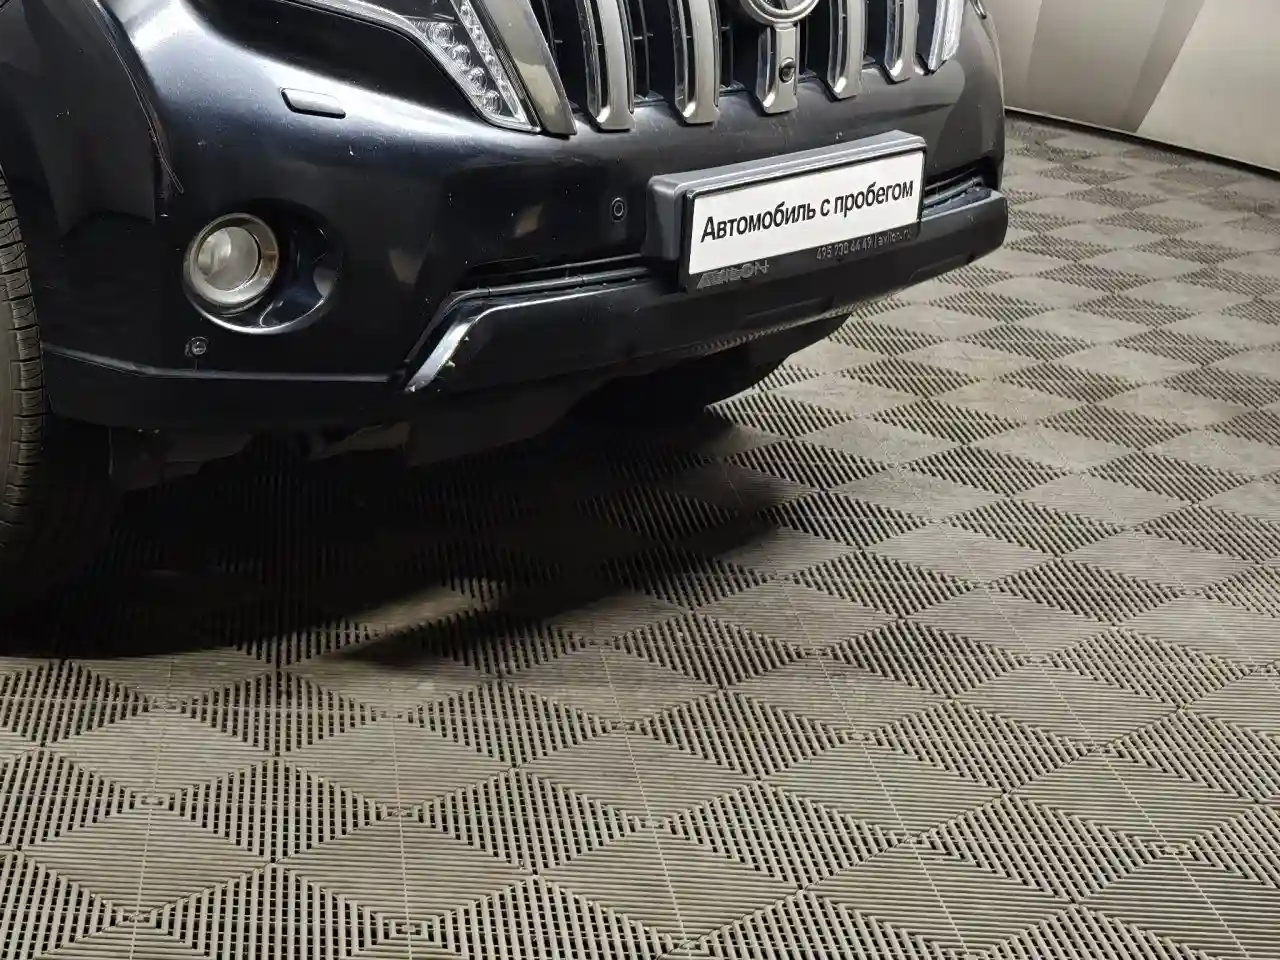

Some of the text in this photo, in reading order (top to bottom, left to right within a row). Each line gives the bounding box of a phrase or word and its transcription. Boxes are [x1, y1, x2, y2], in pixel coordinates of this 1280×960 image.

[700, 179, 914, 243] Автомобиль с пробегом
